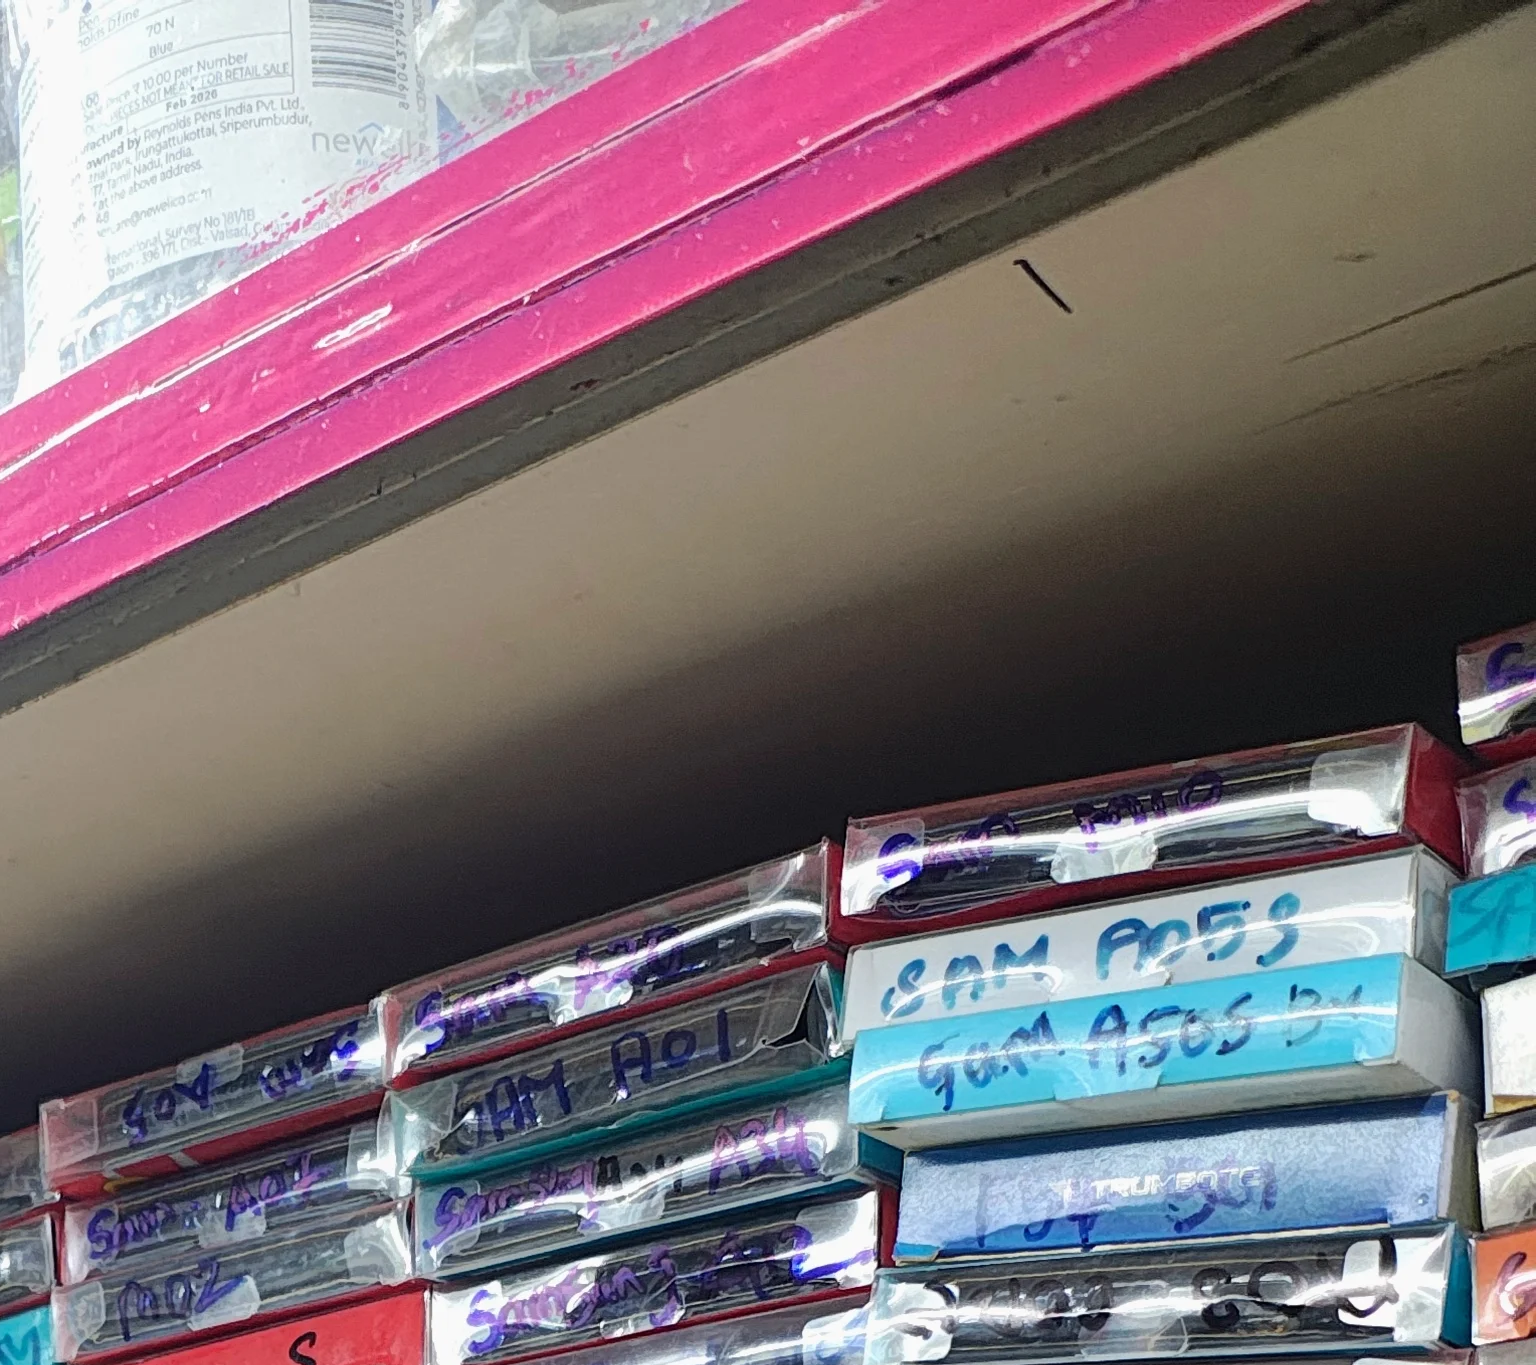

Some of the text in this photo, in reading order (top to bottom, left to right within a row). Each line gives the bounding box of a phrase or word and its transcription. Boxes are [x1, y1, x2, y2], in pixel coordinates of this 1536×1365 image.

[149, 41, 174, 59] Blue
[174, 52, 248, 81] per Number
[225, 66, 262, 84] RETAIL
[264, 62, 290, 76] SALE
[166, 99, 187, 113] Feb
[126, 135, 142, 152] by
[144, 115, 192, 142] Reynolds
[195, 109, 222, 124] Pens
[224, 103, 253, 118] India
[882, 934, 1049, 1018] SAM
[611, 1009, 731, 1095] A01
